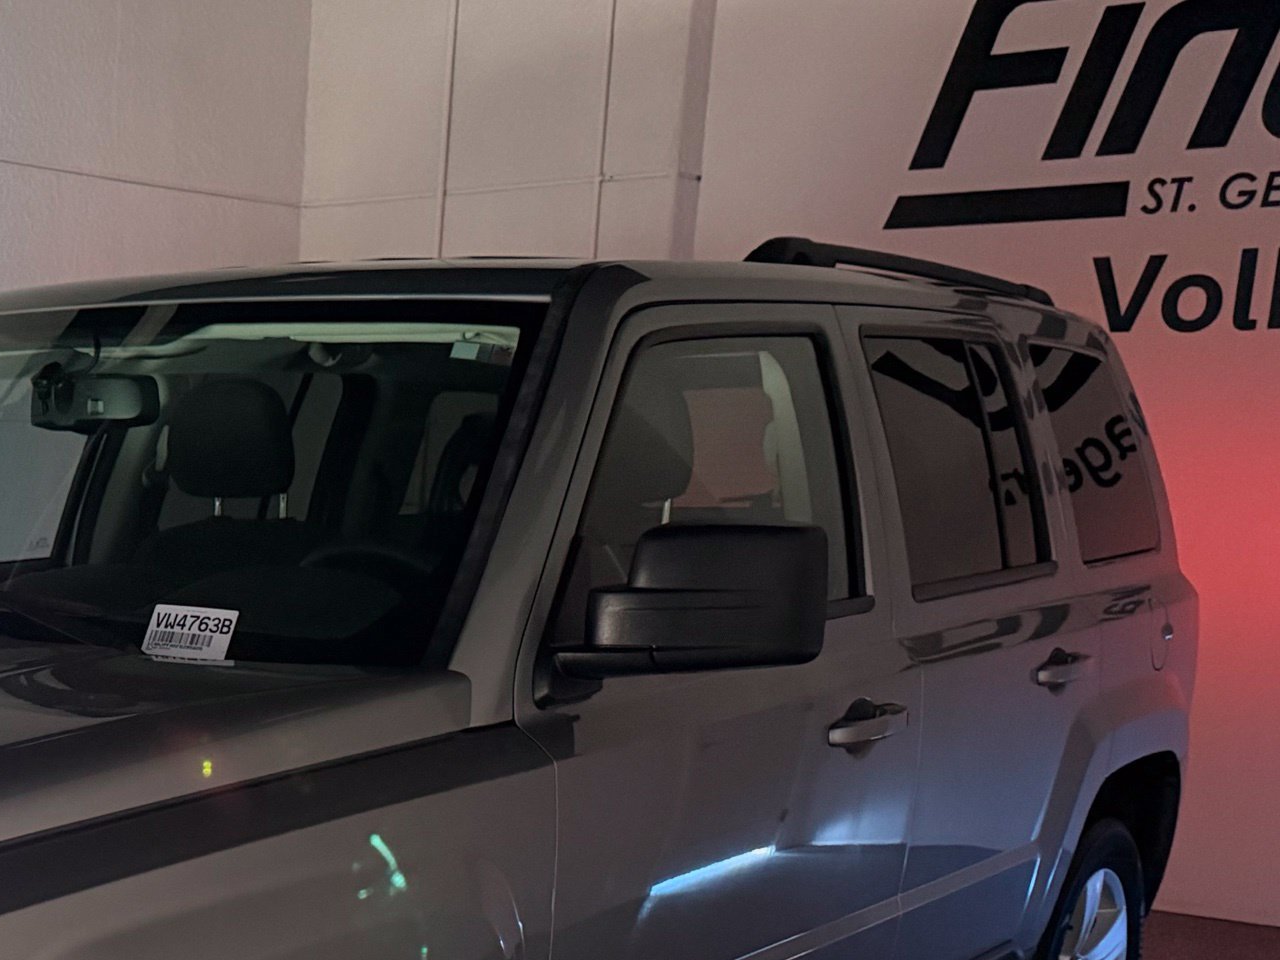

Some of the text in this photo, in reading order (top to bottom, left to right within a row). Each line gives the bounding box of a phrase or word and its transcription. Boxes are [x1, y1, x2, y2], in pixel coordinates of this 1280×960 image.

[908, 0, 1280, 170] Fin
[1141, 176, 1197, 215] ST.
[156, 611, 233, 635] VW4763B
